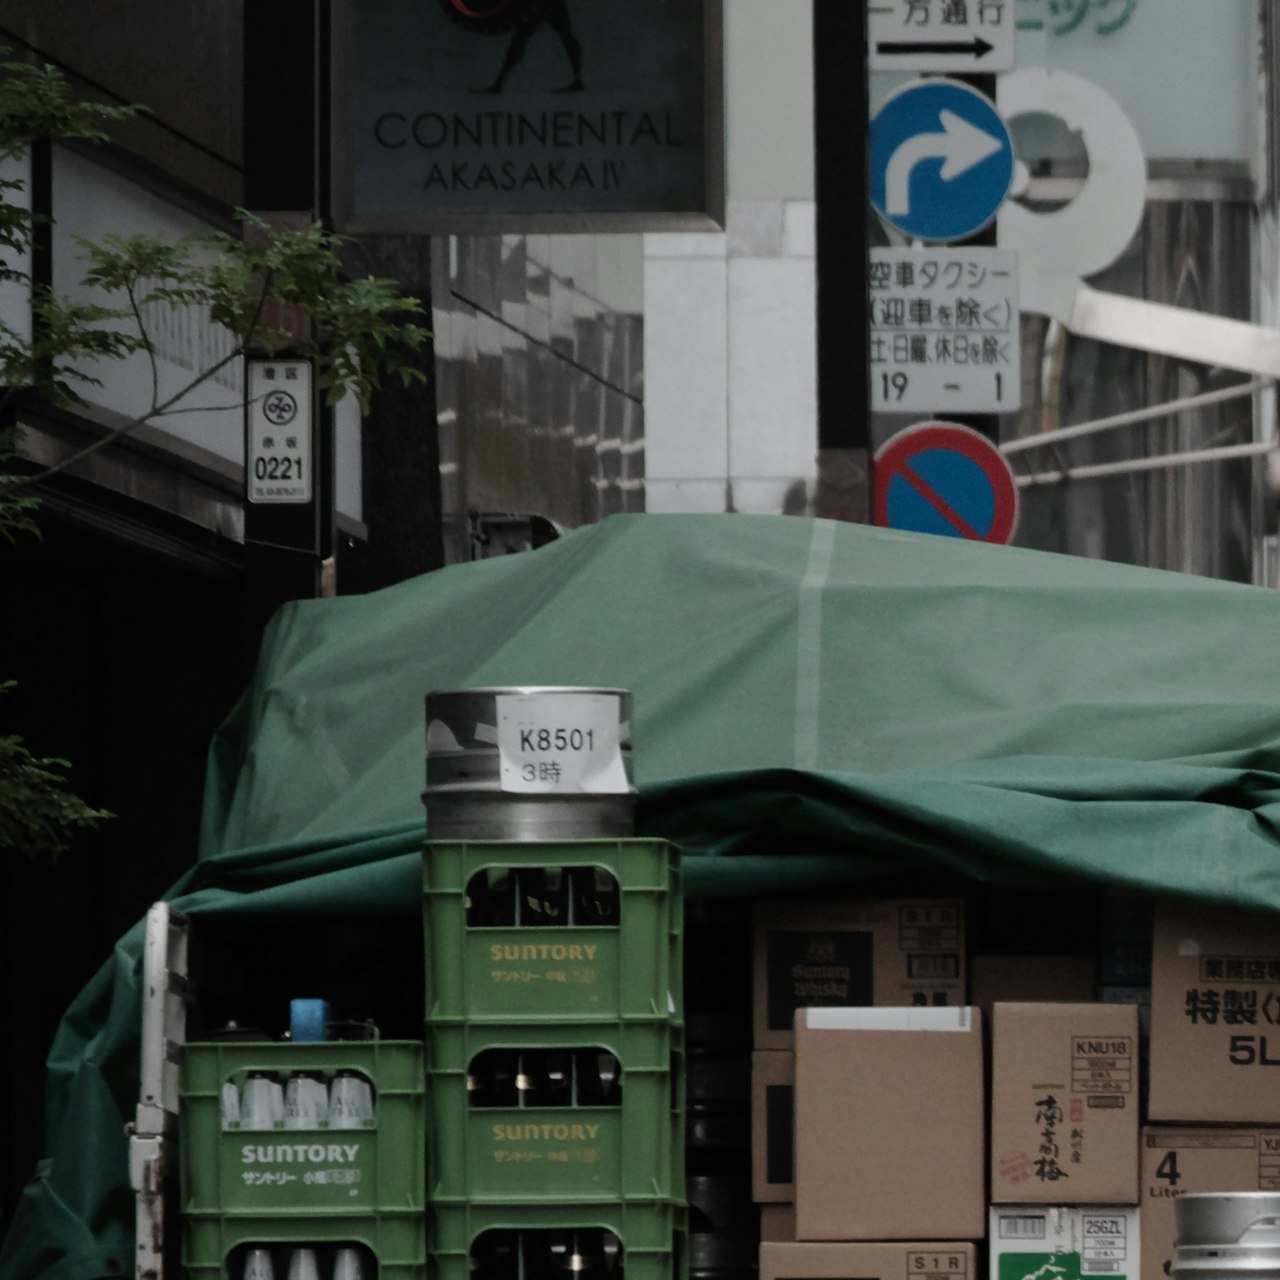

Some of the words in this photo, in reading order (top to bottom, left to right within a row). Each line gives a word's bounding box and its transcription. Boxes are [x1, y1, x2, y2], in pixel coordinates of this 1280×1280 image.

[374, 111, 689, 150] CONTINENTAL
[423, 160, 595, 191] AKASAKA
[870, 261, 1009, 289] 空車タクシー
[882, 372, 908, 401] 19
[995, 372, 1003, 402] 1
[255, 456, 303, 481] 0221
[520, 728, 594, 752] K8501
[522, 761, 562, 783] 3時
[1076, 1040, 1128, 1054] KNU18
[241, 1171, 298, 1186] サントリー
[1155, 1151, 1181, 1187] 4
[914, 1256, 926, 1270] S
[932, 1257, 940, 1270] 1
[948, 1256, 961, 1270] R
